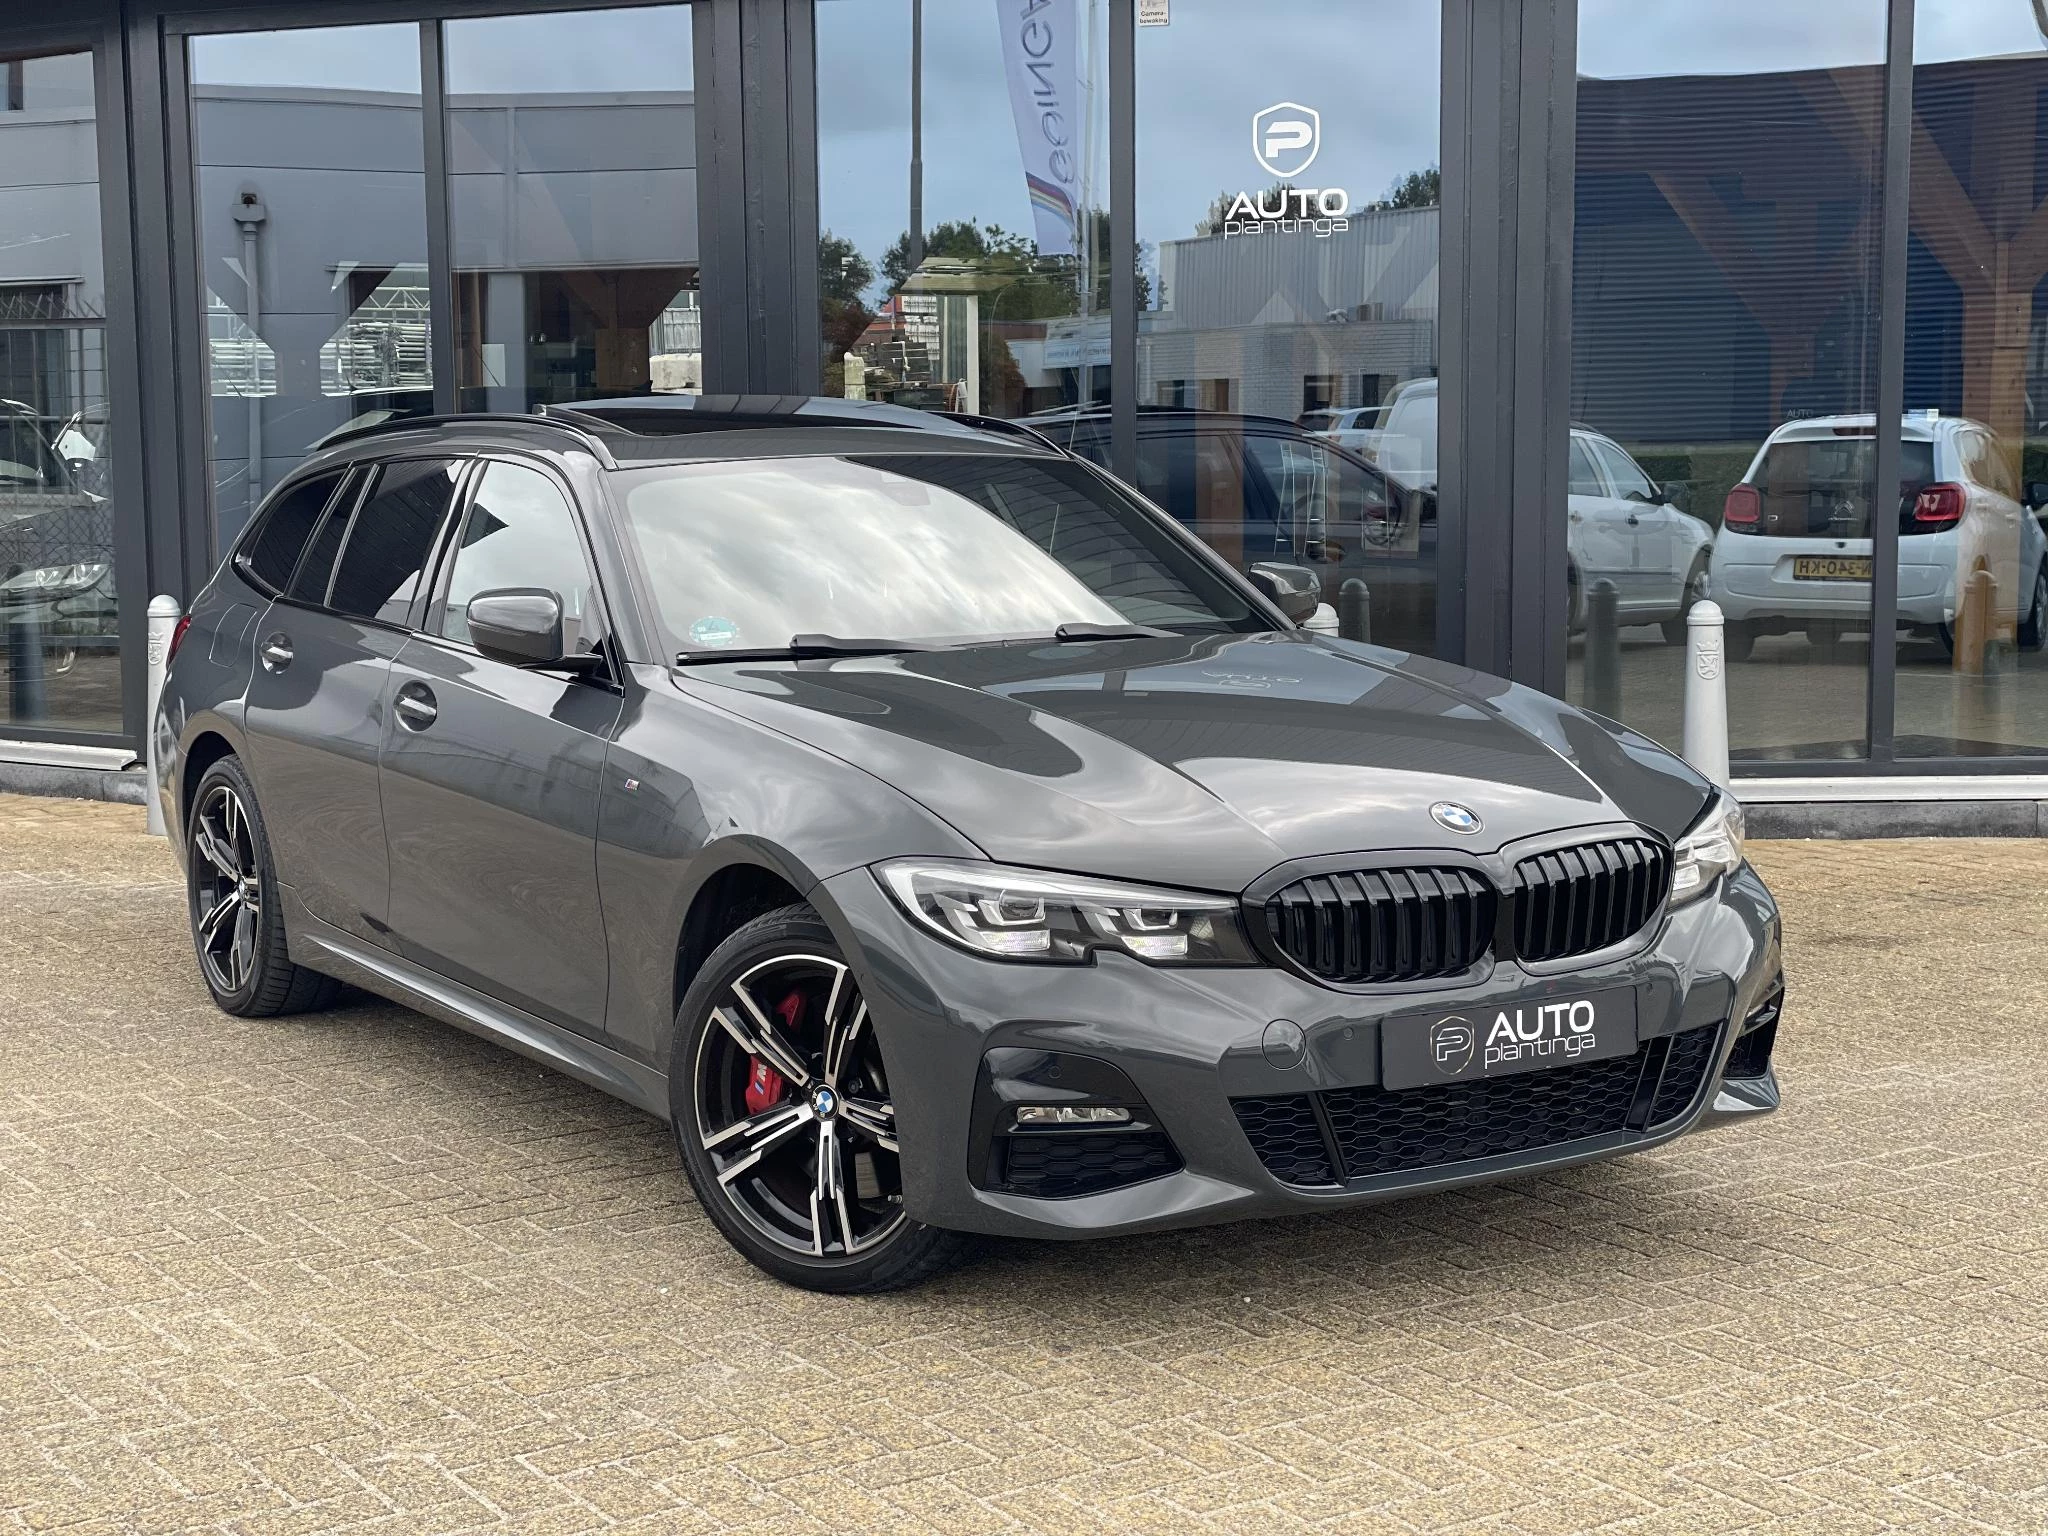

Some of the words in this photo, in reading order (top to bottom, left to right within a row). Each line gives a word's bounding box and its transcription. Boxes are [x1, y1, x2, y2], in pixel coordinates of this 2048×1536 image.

[1265, 121, 1313, 158] P
[1225, 188, 1349, 220] AUTO
[1224, 217, 1349, 240] plantinga
[1485, 1000, 1595, 1047] AUTO
[1484, 1033, 1596, 1070] plantinga
